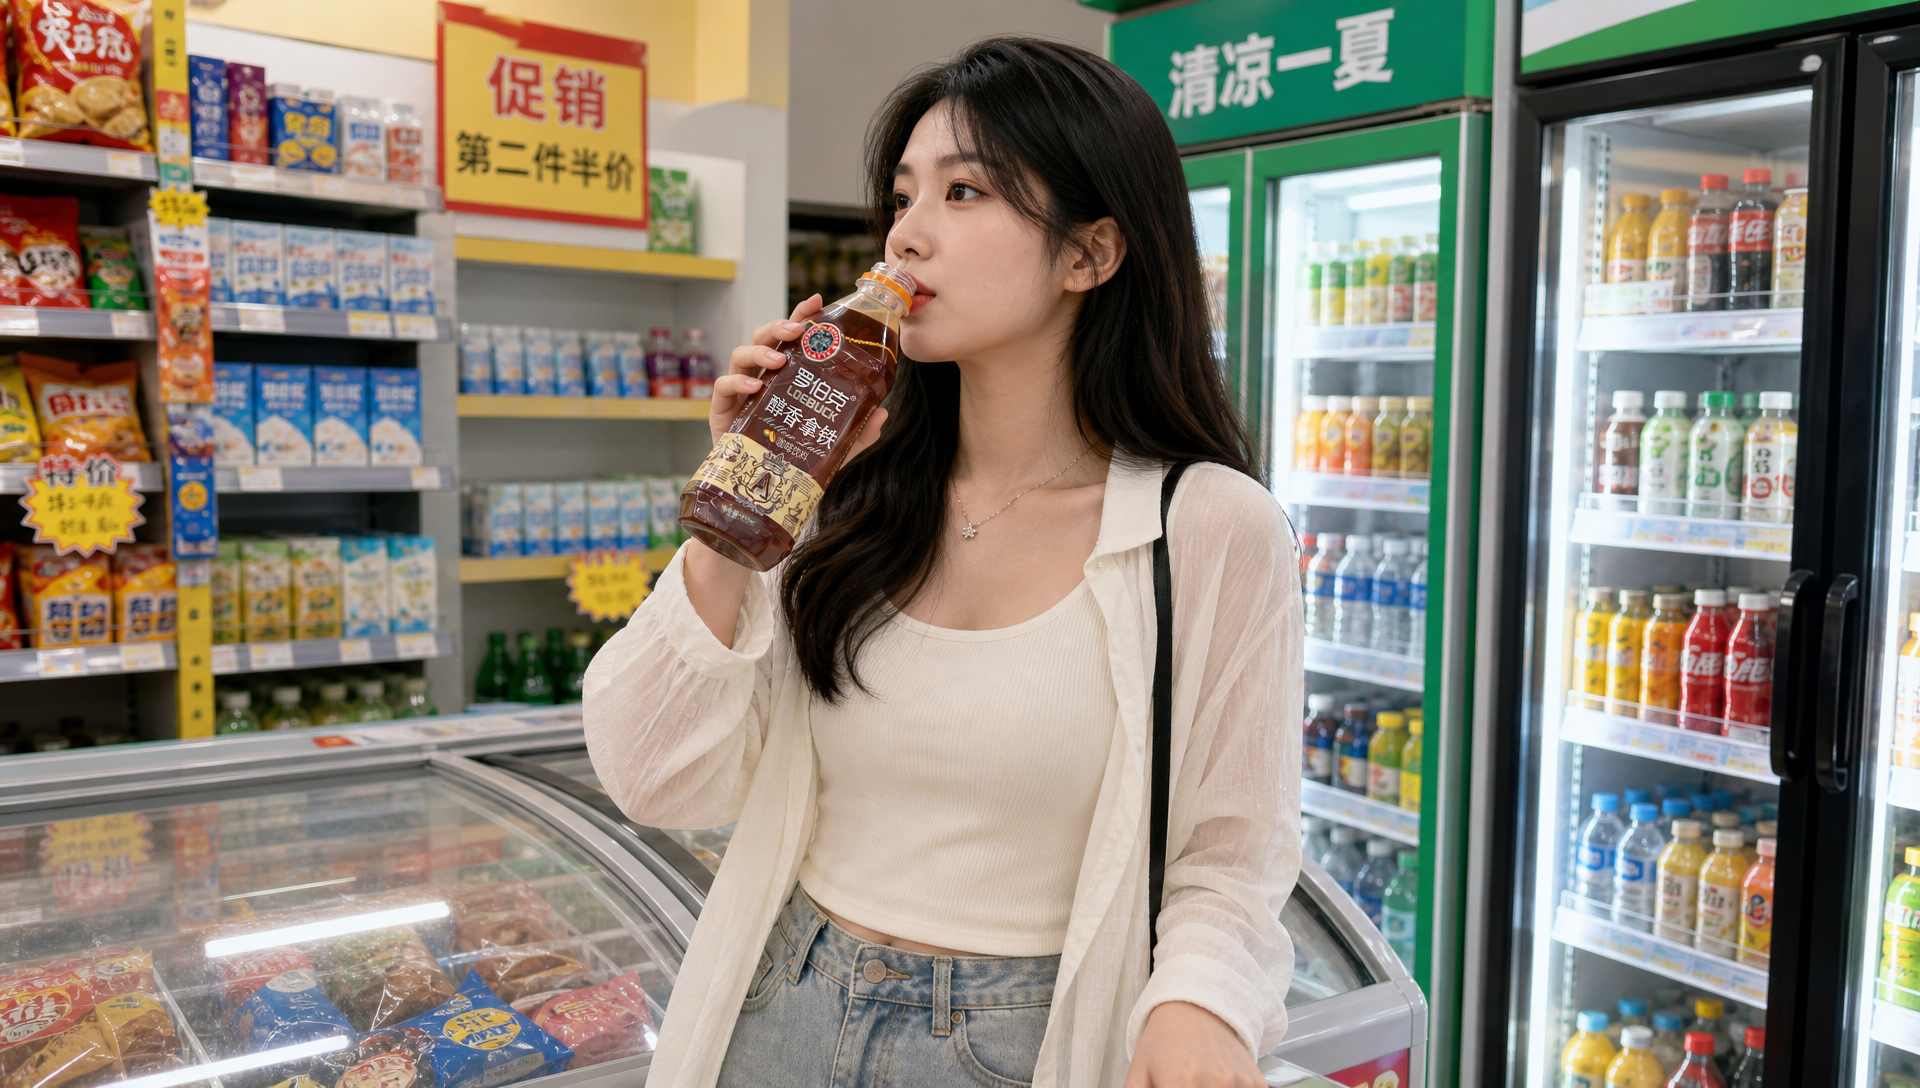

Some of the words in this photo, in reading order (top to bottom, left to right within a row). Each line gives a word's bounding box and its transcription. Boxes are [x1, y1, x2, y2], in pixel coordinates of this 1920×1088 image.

[1167, 7, 1396, 121] 清凉一夏
[485, 53, 608, 131] 促销
[456, 131, 636, 193] 第二件半价
[786, 385, 839, 422] LOEBUCK
[792, 367, 850, 412] 罗伯克
[765, 394, 837, 449] 醇香拿铁
[43, 456, 118, 488] 特价
